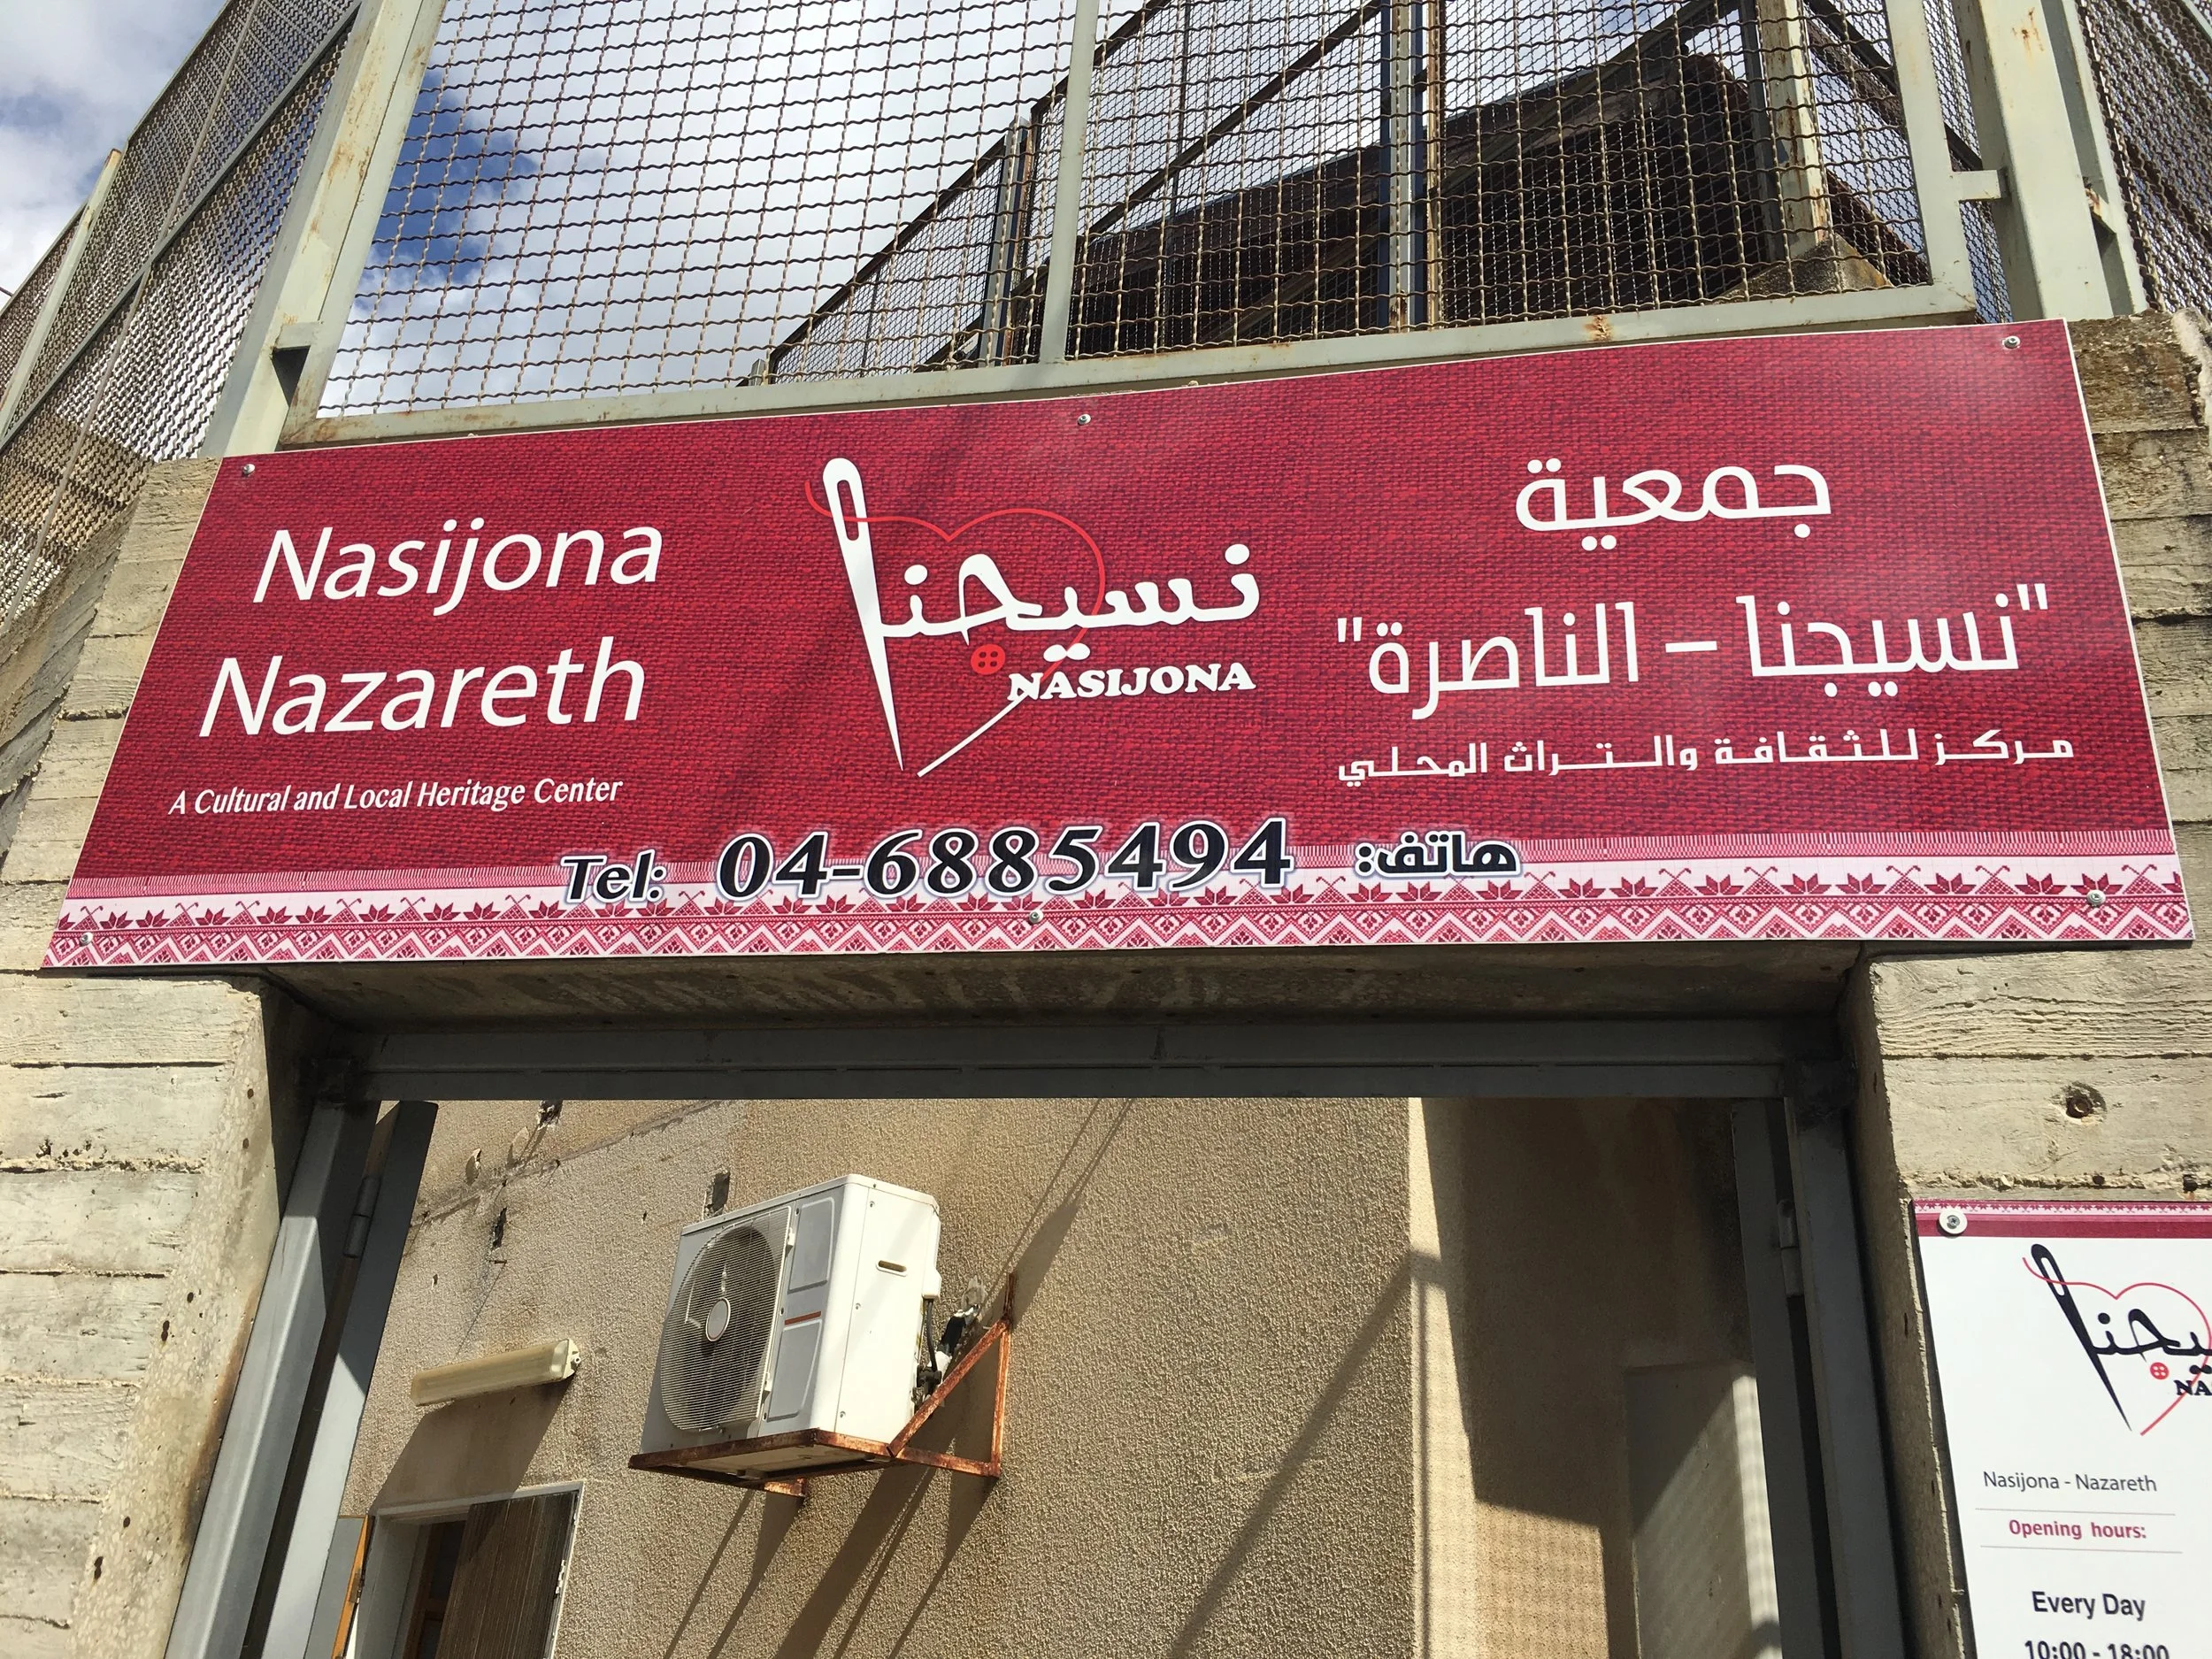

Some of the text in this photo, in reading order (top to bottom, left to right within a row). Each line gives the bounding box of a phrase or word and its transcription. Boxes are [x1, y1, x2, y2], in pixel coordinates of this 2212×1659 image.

[1516, 457, 1832, 551] جمعية
[252, 517, 663, 617] Nasijona
[822, 457, 1260, 771] نسيجنا
[1735, 582, 2048, 697] "نسيجنا
[198, 635, 645, 737] Nazareth
[1006, 662, 1256, 702] NASIJONA
[1337, 601, 1639, 720] الناصرة"
[1338, 727, 2074, 787] مركز للثقافة والتراث المحلي
[167, 777, 624, 815] A Cultural and Local Heritage Center
[563, 821, 1292, 901] Tel: 04-6885494
[1358, 833, 1517, 874] هاتف:
[1983, 1471, 2060, 1493] Nasijona
[2075, 1473, 2157, 1492] Nazareth
[2008, 1519, 2147, 1540] Opening hours:
[2032, 1590, 2146, 1622] Every Day
[2024, 1640, 2086, 1659] 10:00
